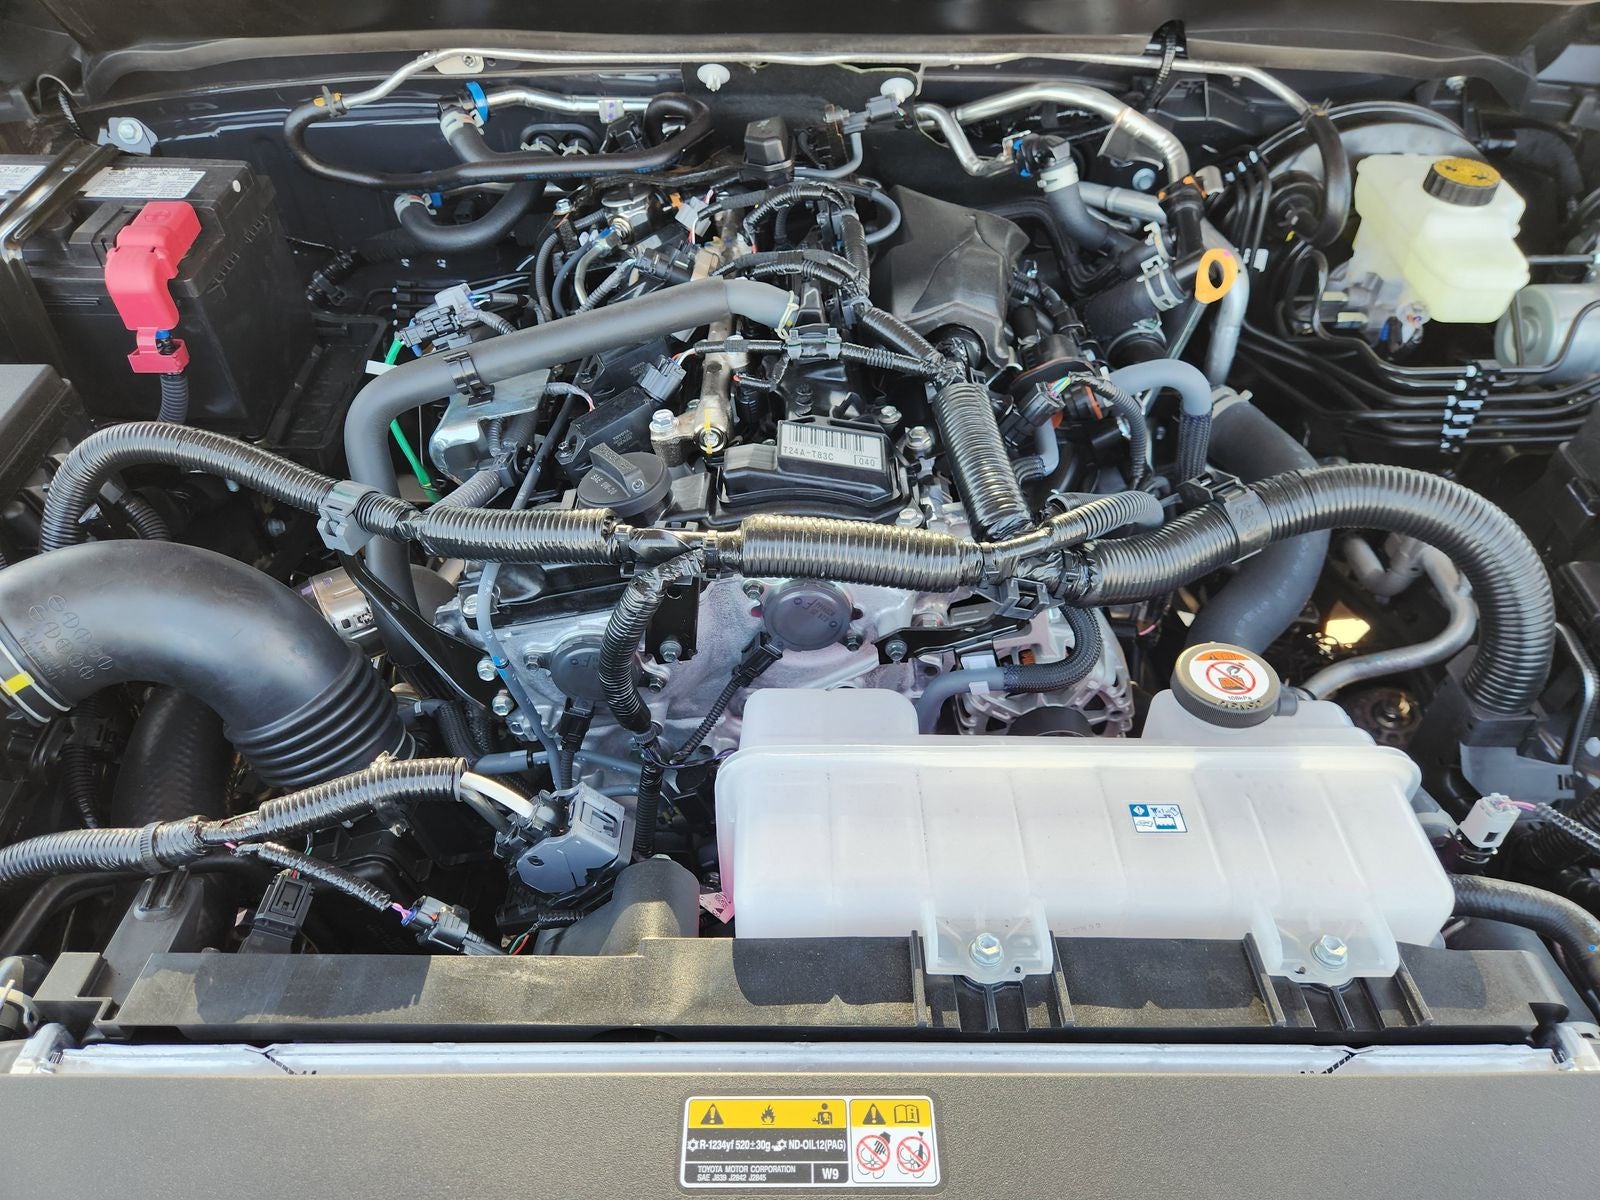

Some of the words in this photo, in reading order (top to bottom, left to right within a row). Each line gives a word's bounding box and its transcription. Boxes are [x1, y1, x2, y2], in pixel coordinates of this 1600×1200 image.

[858, 457, 876, 467] 040
[700, 1139, 734, 1152] R-1234yf
[735, 1139, 771, 1152] 520±30g
[788, 1139, 847, 1151] ND-OIL12(PAG)
[698, 1165, 723, 1173] TOYOTA
[725, 1165, 749, 1173] MOTOR
[751, 1165, 796, 1173] CORPORATION
[822, 1168, 839, 1180] W9
[697, 1174, 710, 1182] SAE
[712, 1174, 727, 1182] J639
[728, 1174, 747, 1182] J2842
[748, 1174, 767, 1182] J2845
